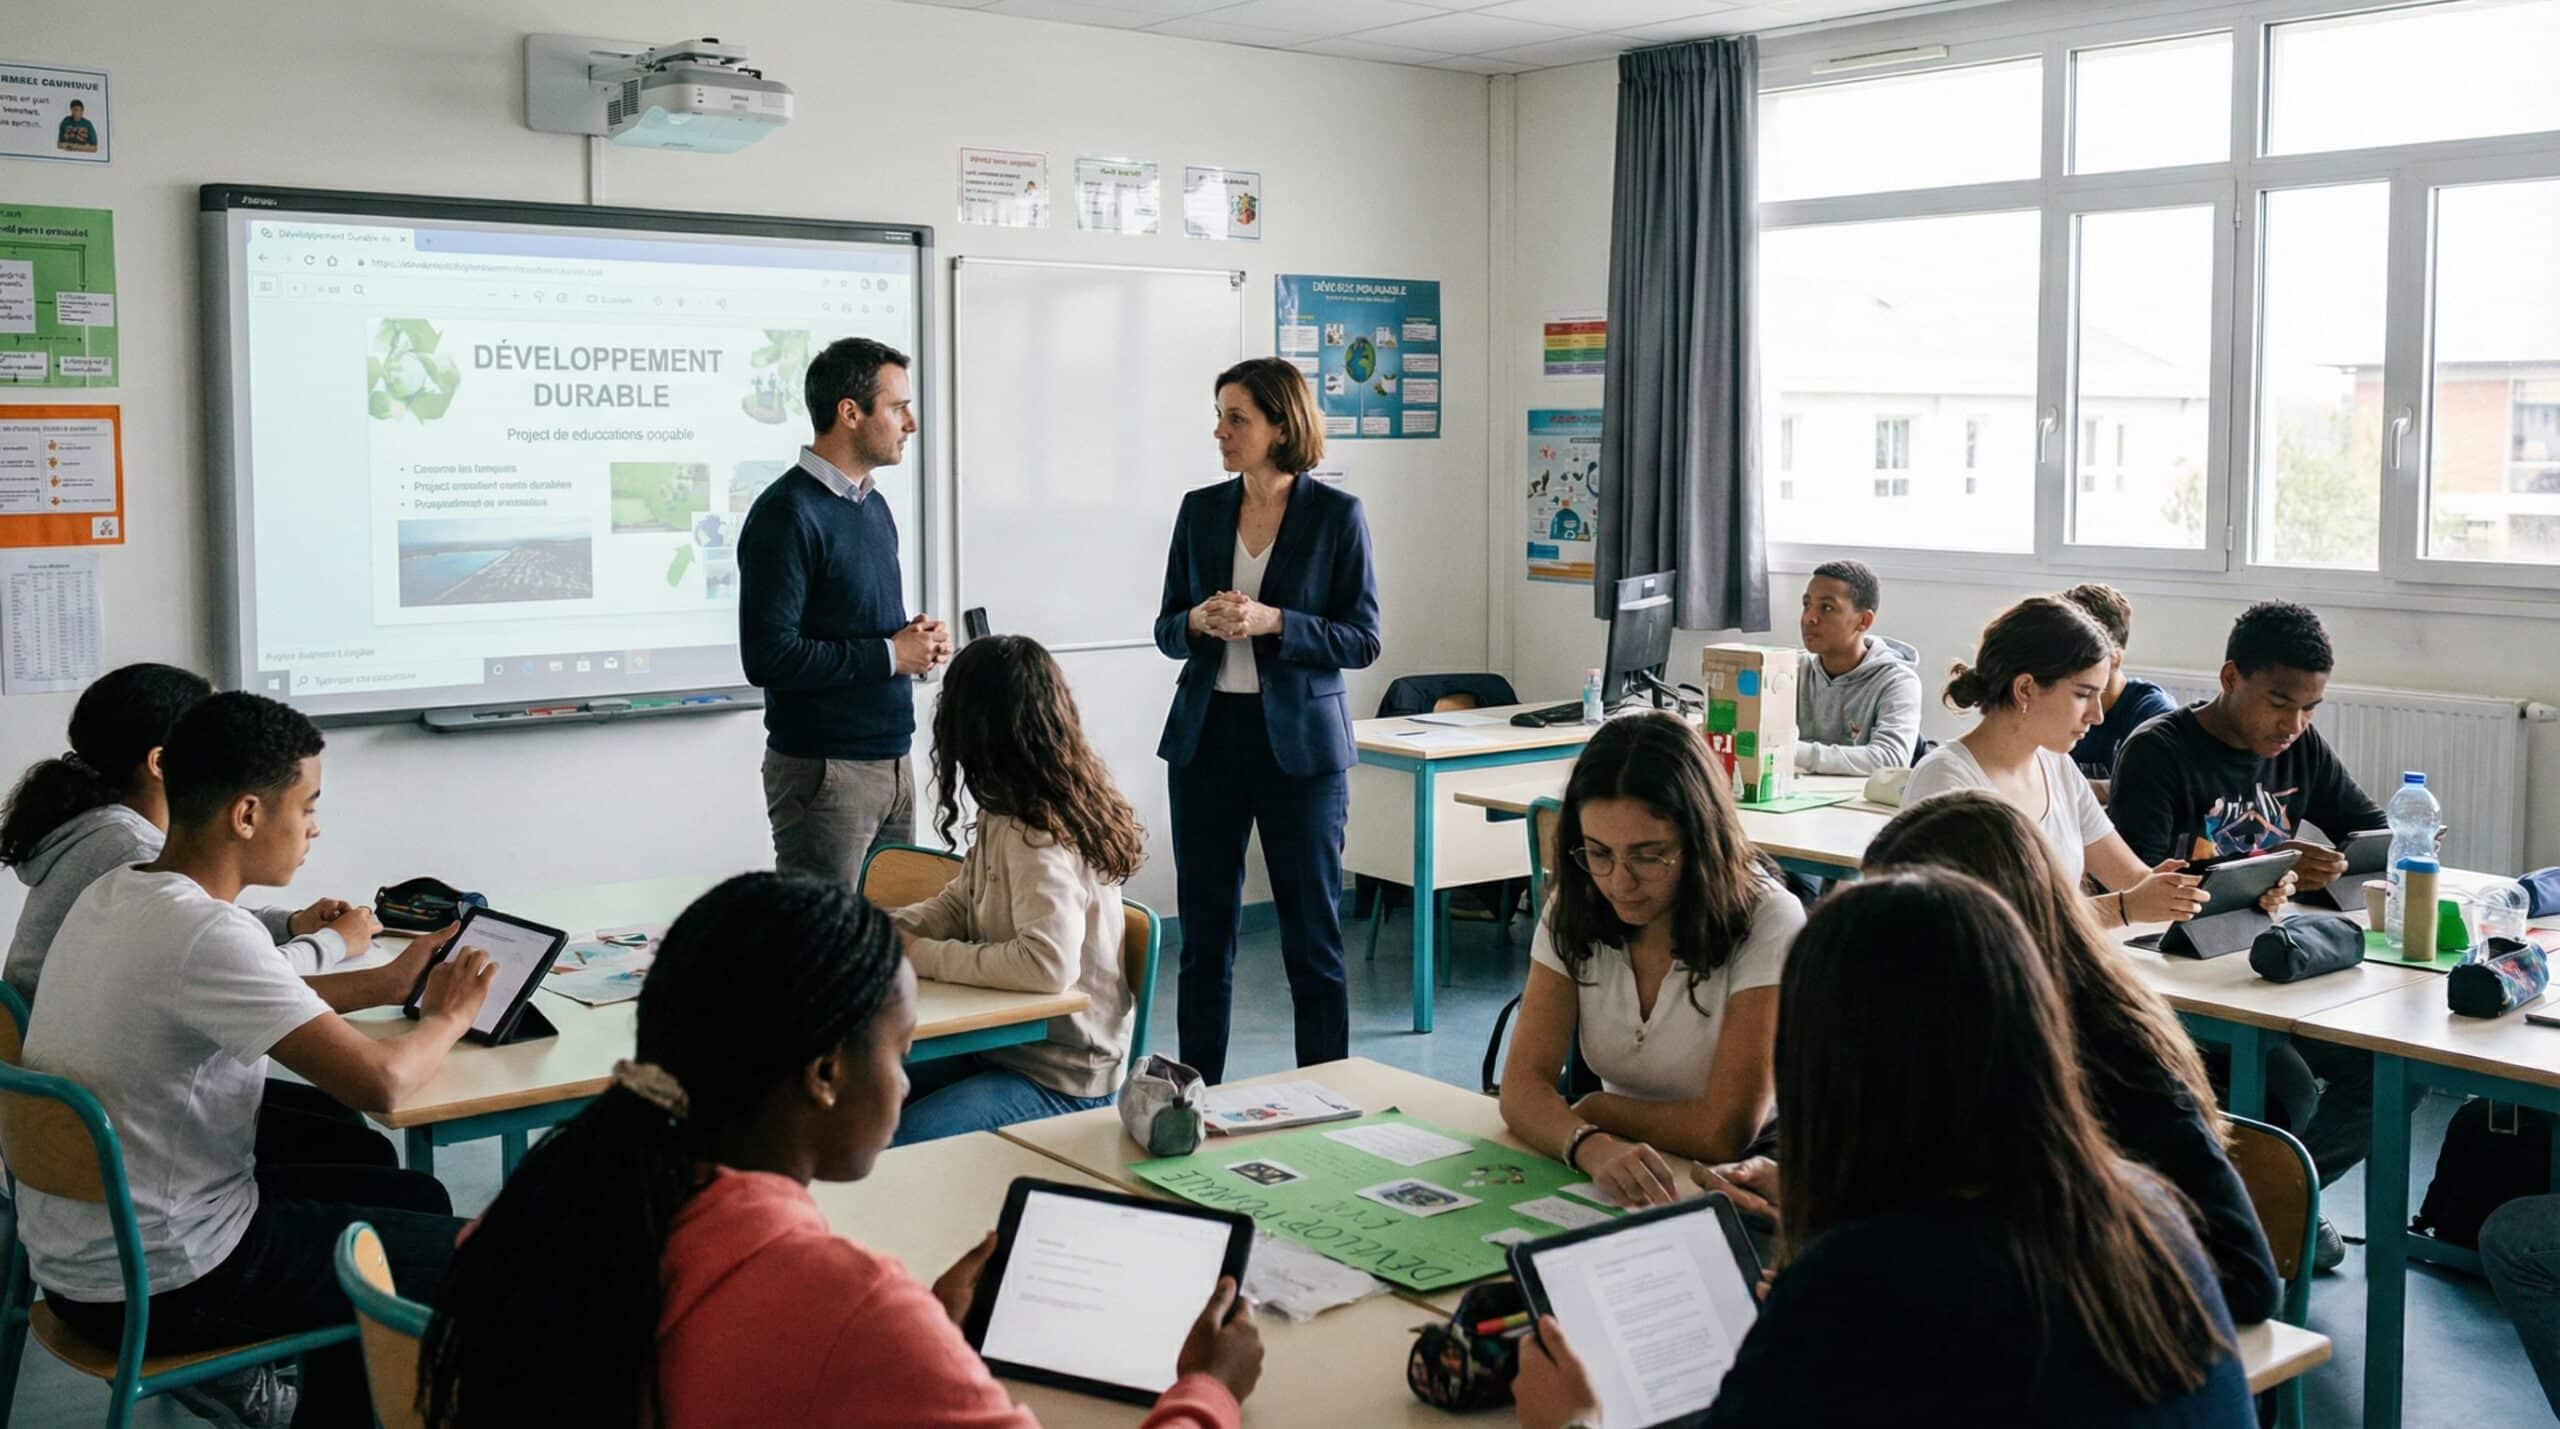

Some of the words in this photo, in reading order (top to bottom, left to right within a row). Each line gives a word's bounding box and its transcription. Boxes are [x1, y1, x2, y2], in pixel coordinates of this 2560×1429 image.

[474, 339, 723, 373] DÉVELOPPEMENT
[534, 382, 670, 408] DURABLE
[507, 428, 550, 444] Project
[553, 428, 569, 441] de
